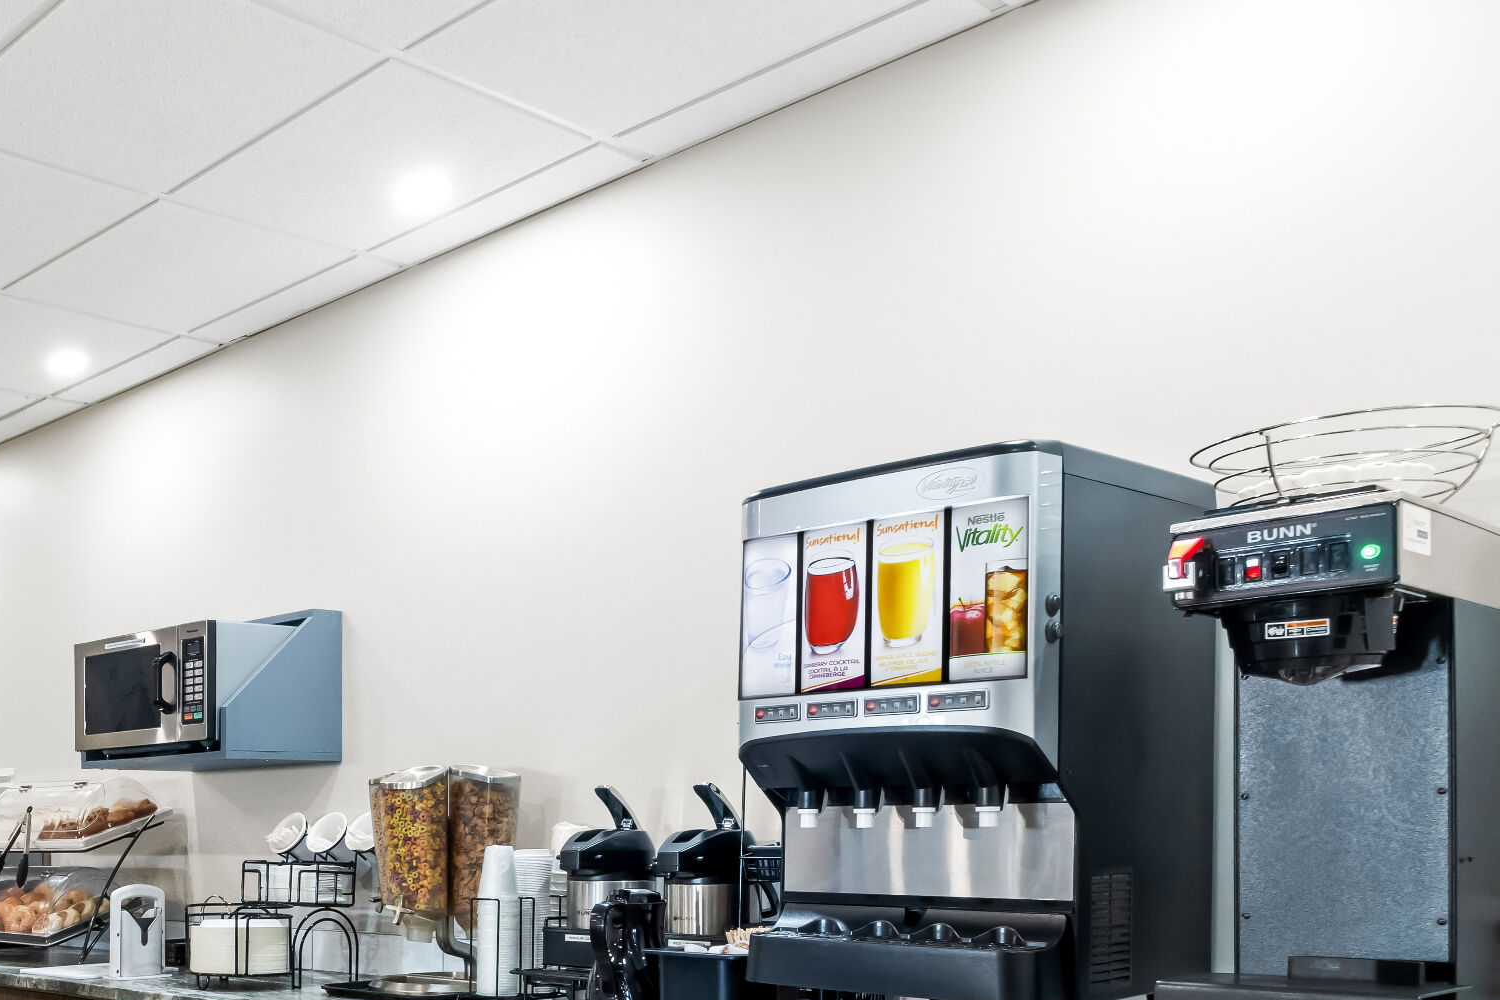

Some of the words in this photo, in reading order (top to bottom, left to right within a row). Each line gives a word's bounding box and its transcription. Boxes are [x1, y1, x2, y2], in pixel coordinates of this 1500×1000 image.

[876, 514, 939, 537] Sunsational
[967, 511, 1006, 526] Nestlé
[805, 528, 861, 550] Sunsational
[956, 523, 1024, 553] Vitality
[1247, 523, 1313, 544] BUNN
[829, 658, 861, 666] COCKTAIL
